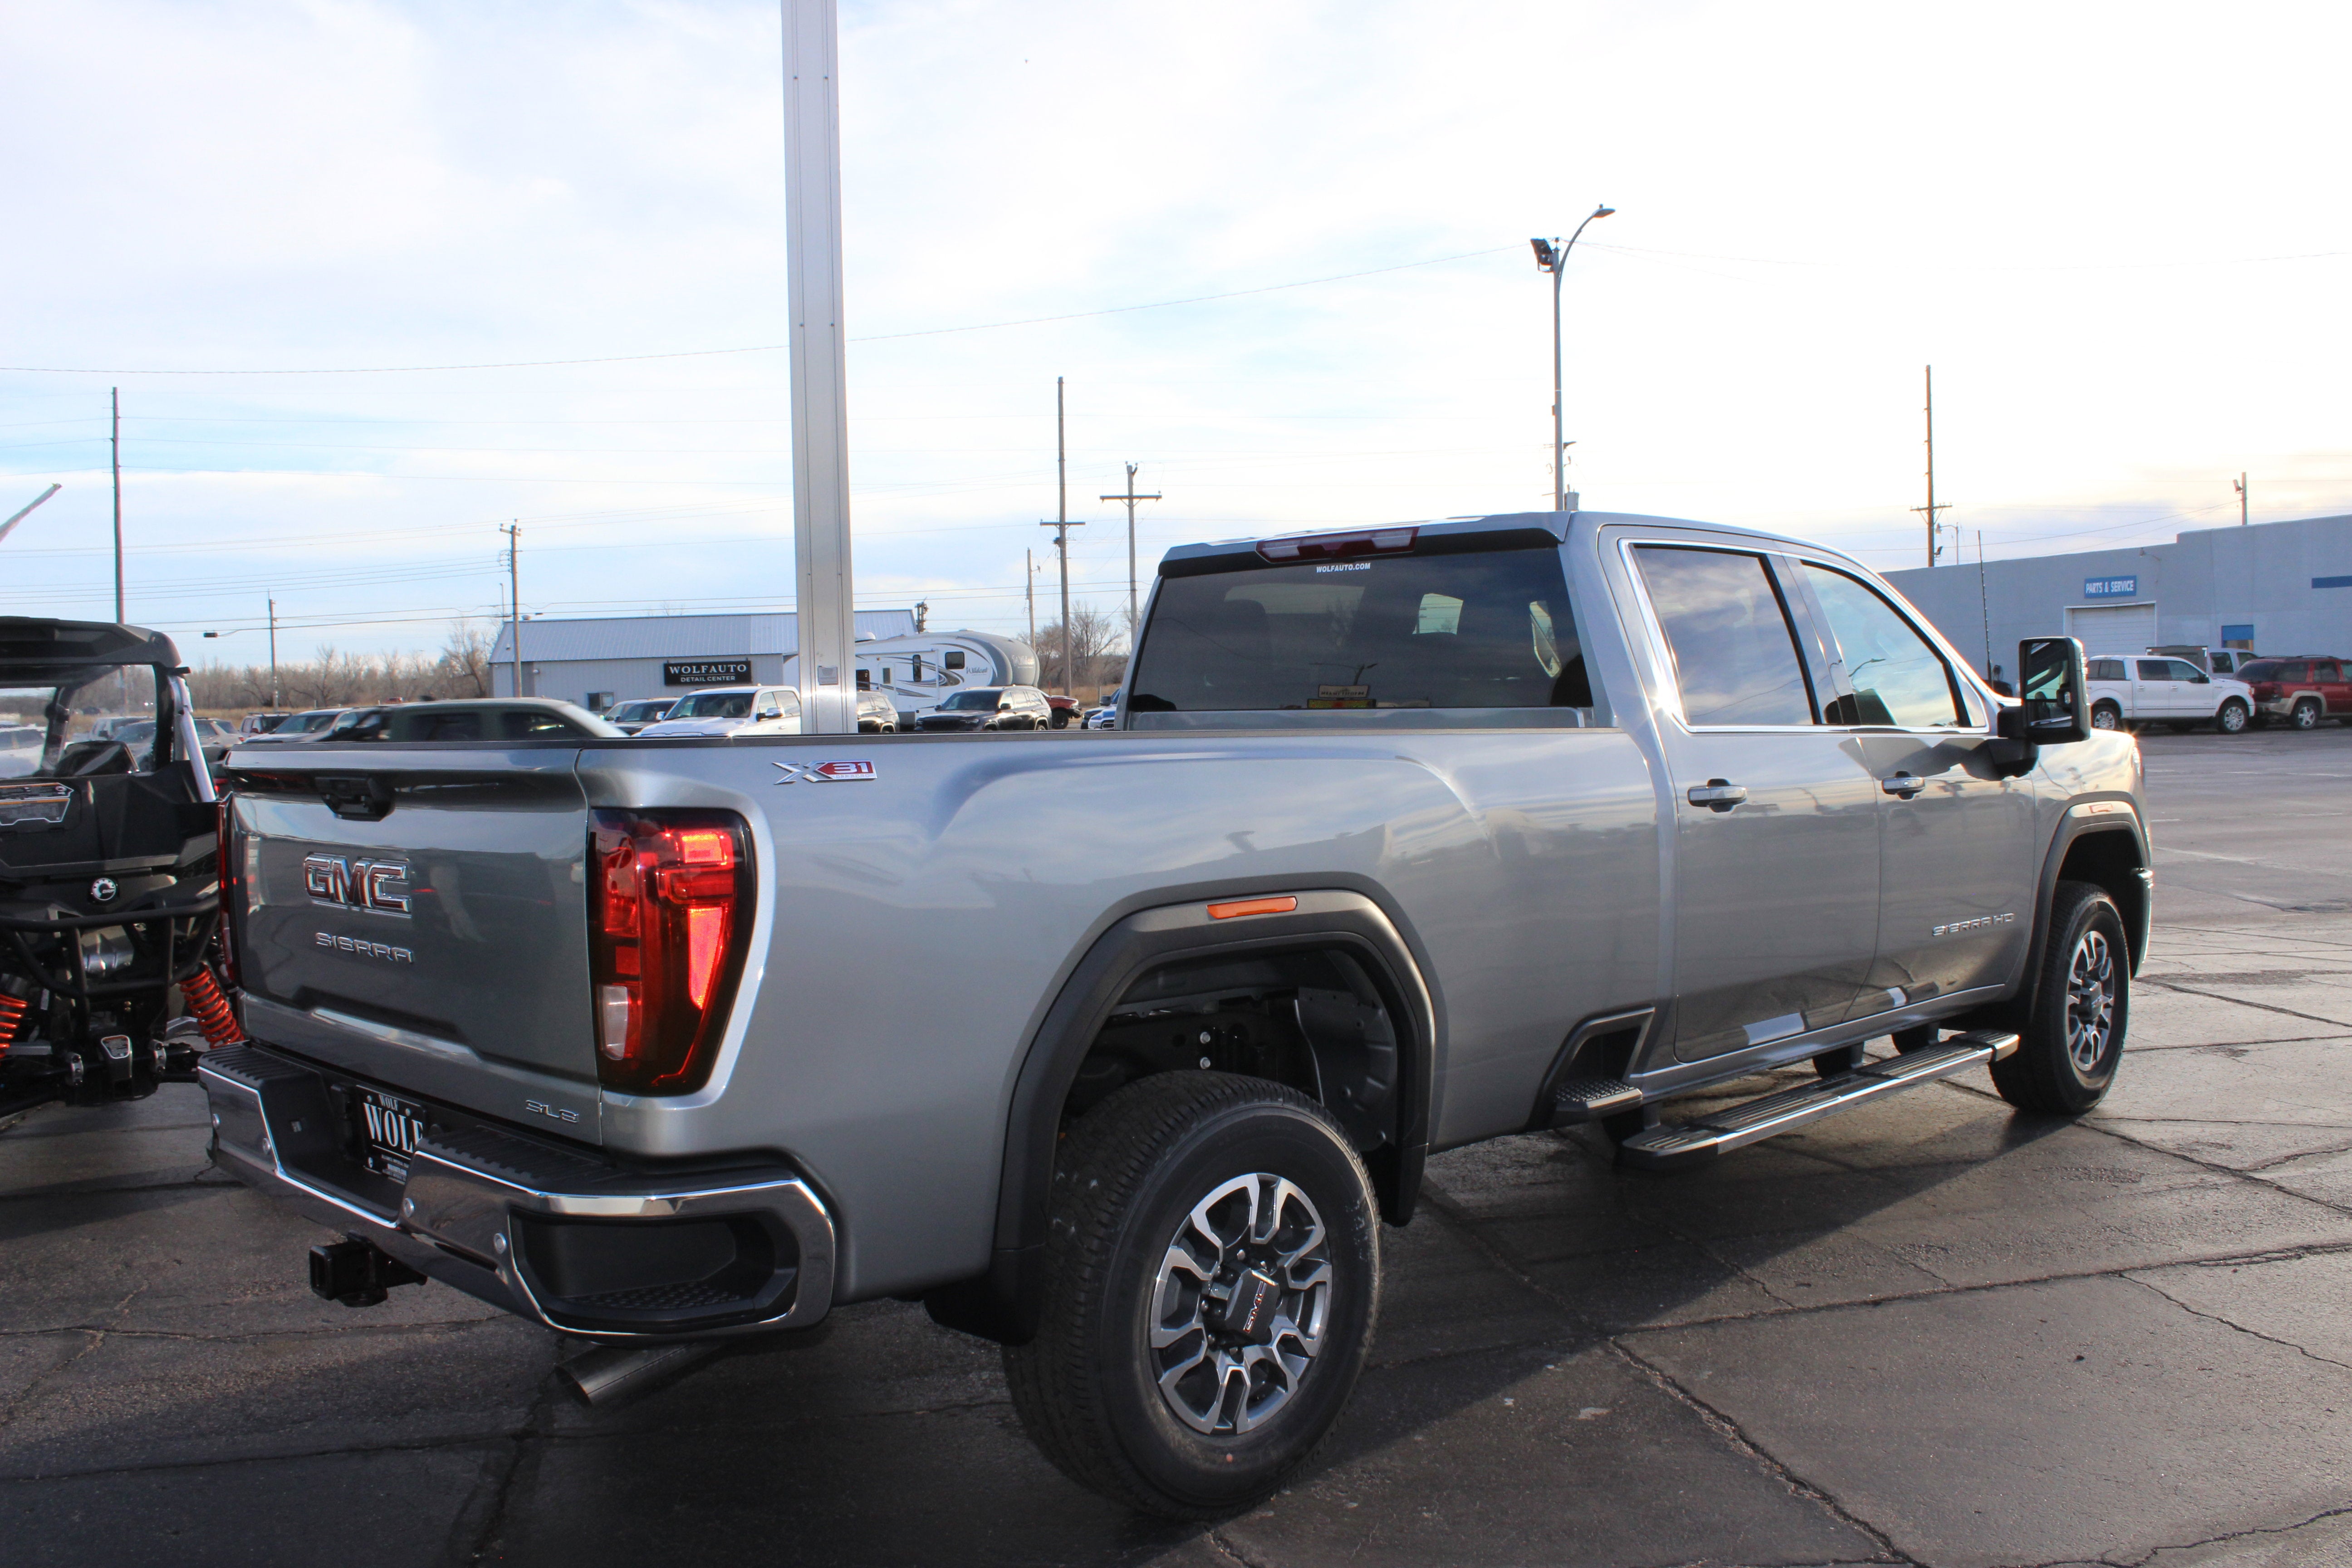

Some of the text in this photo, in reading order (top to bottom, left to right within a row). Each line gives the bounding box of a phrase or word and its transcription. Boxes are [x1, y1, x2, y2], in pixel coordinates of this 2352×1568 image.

[1316, 563, 1371, 573] WOLFAUTO.COM
[2085, 580, 2134, 594] PARTS & SERVICE
[669, 664, 747, 674] WOLFAUTO
[772, 761, 872, 785] X31
[304, 853, 412, 917] GMC
[1932, 912, 2015, 936] SIERRA HD
[315, 932, 414, 964] SIERRA
[378, 1094, 399, 1111] WOLF
[363, 1102, 423, 1153] WOLF
[1243, 1280, 1267, 1334] GMC
